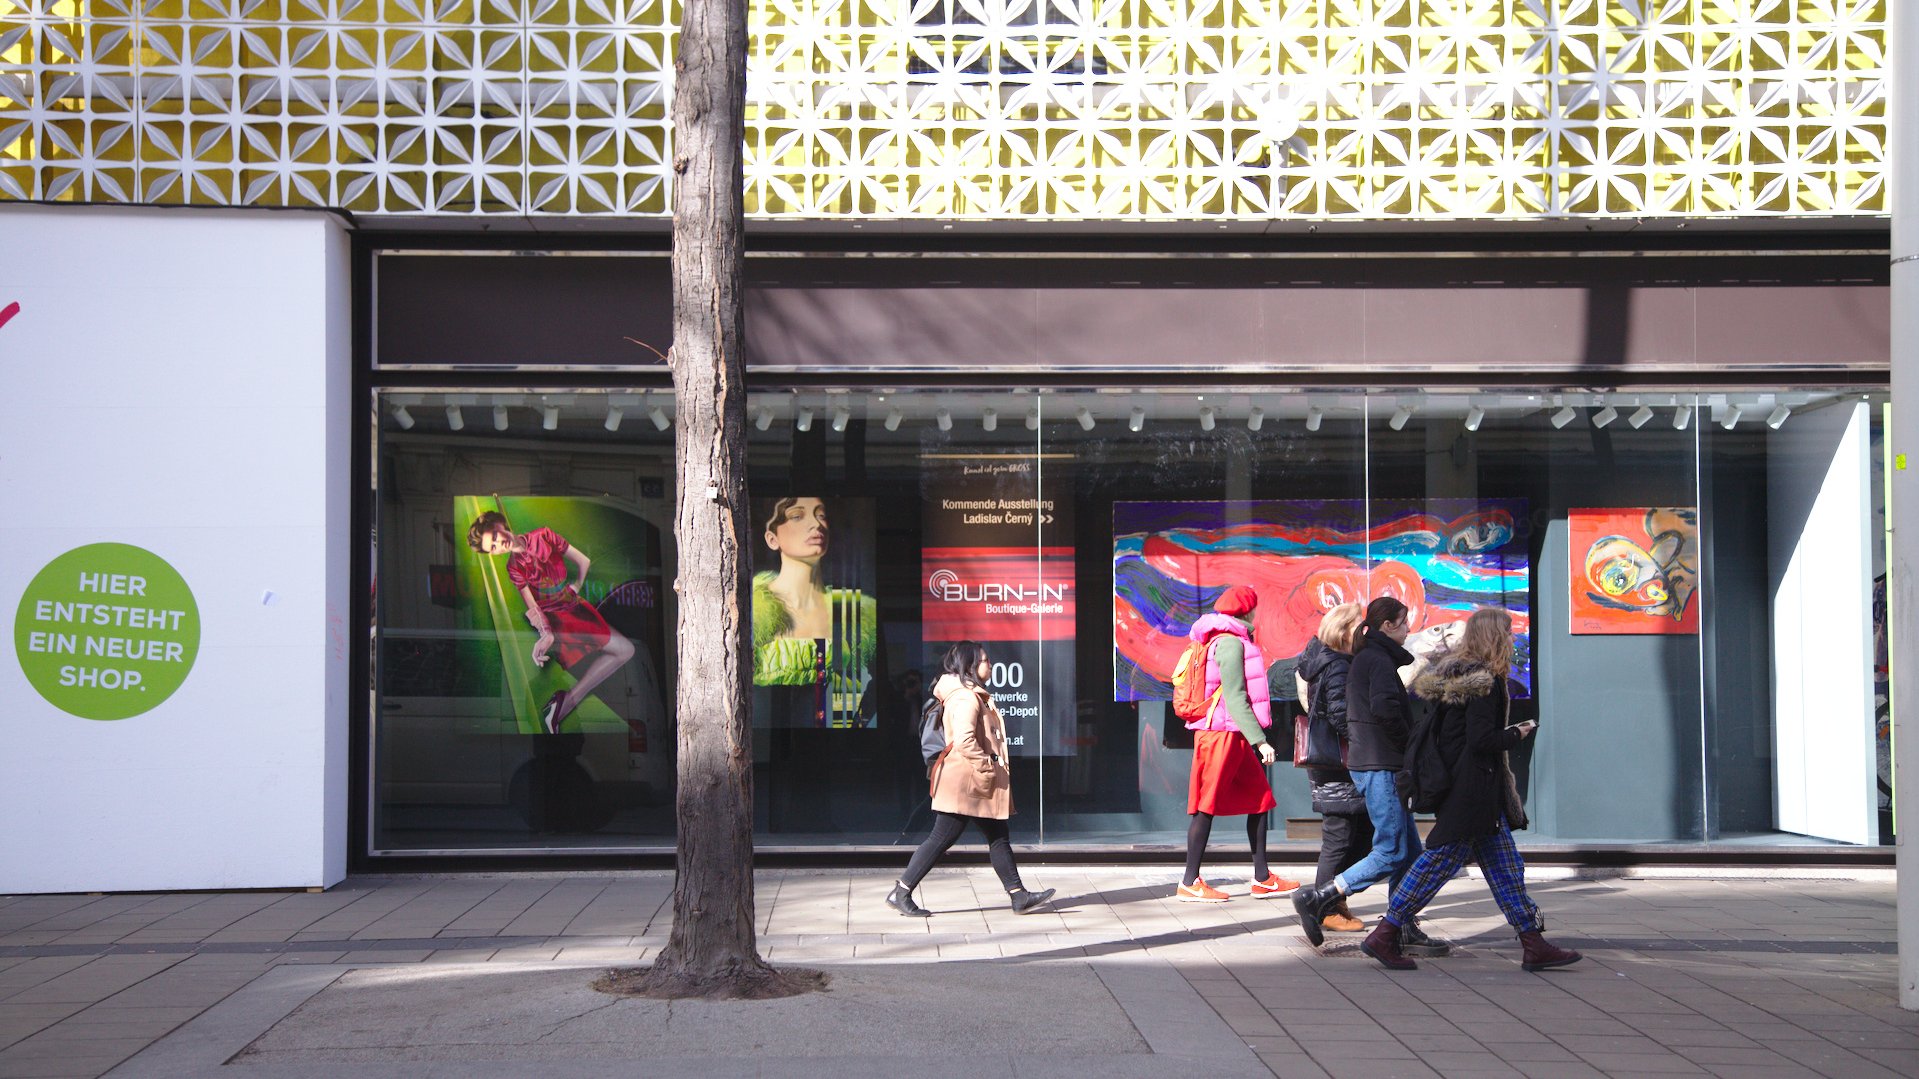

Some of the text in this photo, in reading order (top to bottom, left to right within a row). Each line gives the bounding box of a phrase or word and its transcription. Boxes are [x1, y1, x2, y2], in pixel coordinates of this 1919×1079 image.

[942, 499, 1054, 511] Kommende Ausstellung
[963, 511, 1033, 526] Ladislav Černý
[79, 571, 147, 597] HIER
[35, 600, 186, 631] ENTSTEHT
[985, 603, 1064, 616] Boutique-Galerie
[28, 631, 184, 663] EIN NEUER
[59, 665, 146, 692] SHOP.
[985, 662, 1024, 688] 00
[990, 692, 1028, 702] stwerke
[999, 706, 1038, 718] e-Depot
[1006, 735, 1024, 746] n.at
